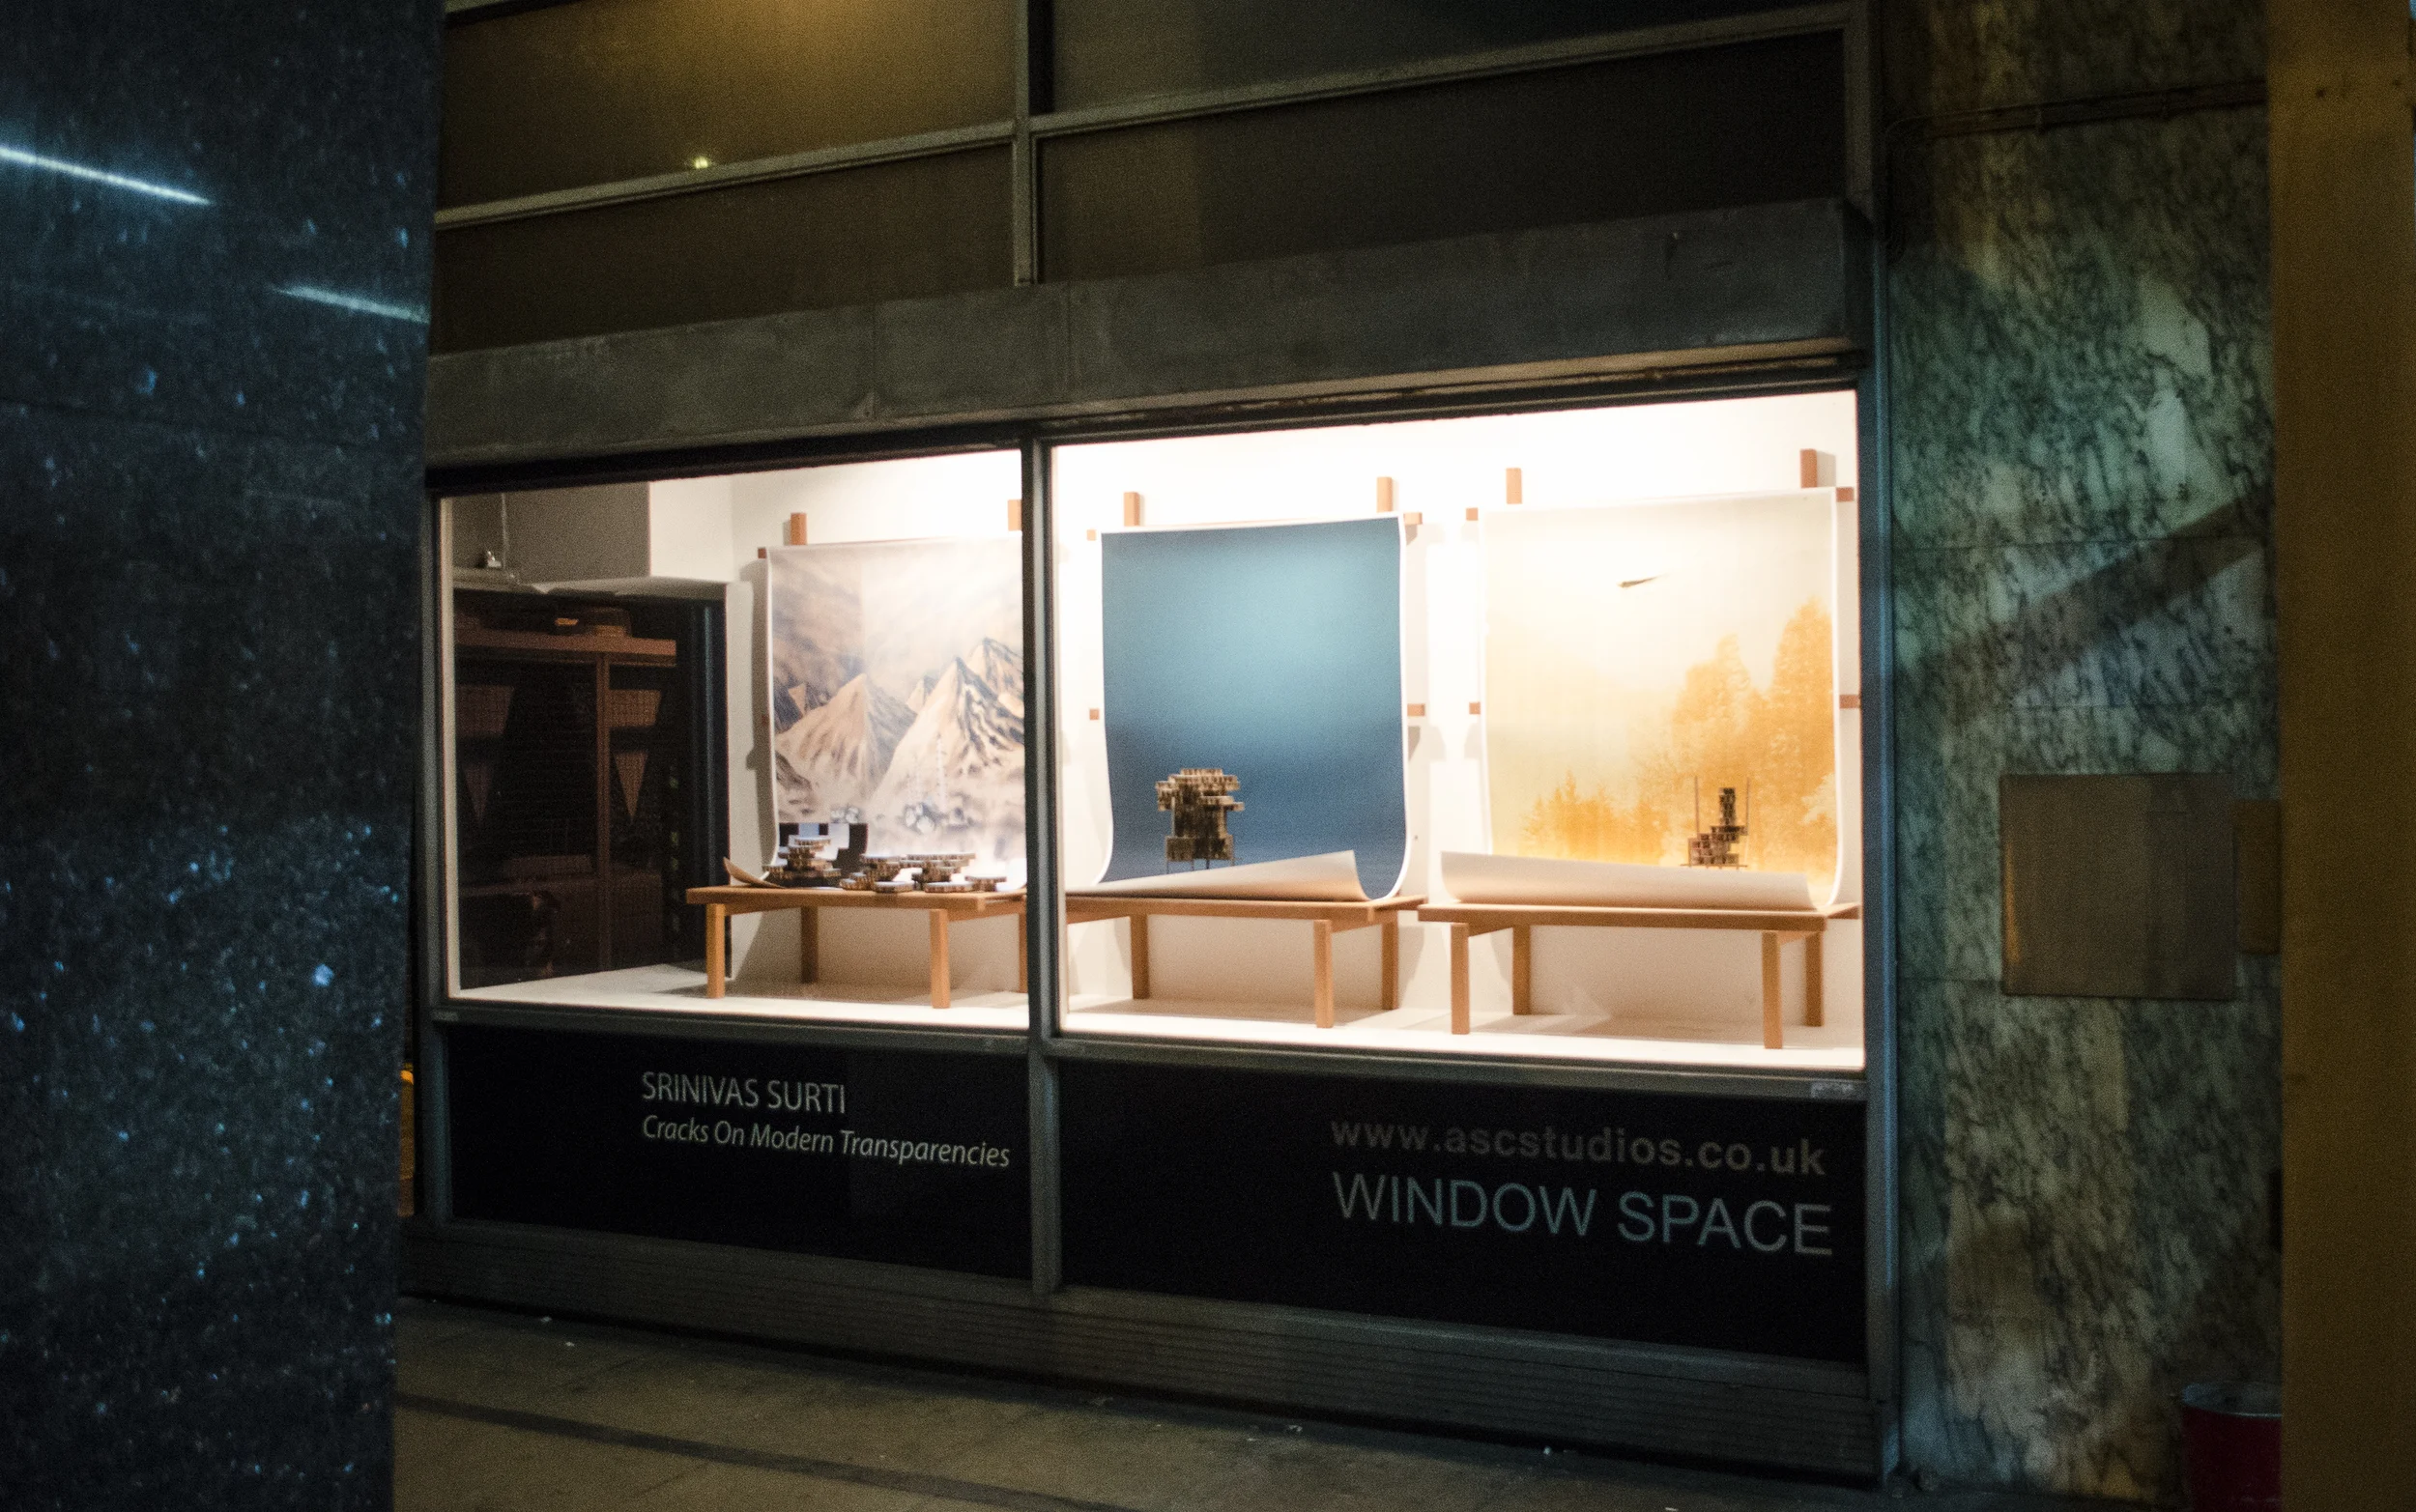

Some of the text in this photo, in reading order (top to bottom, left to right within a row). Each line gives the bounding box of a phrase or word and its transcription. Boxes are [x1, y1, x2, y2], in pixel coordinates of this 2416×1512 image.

[642, 1070, 847, 1114] SRINIVAS SURTI
[643, 1114, 1011, 1167] Cracks On Modern Transparencies
[1330, 1120, 1826, 1176] www.ascstudios.co.uk
[1332, 1170, 1833, 1257] WINDOW SPACE
